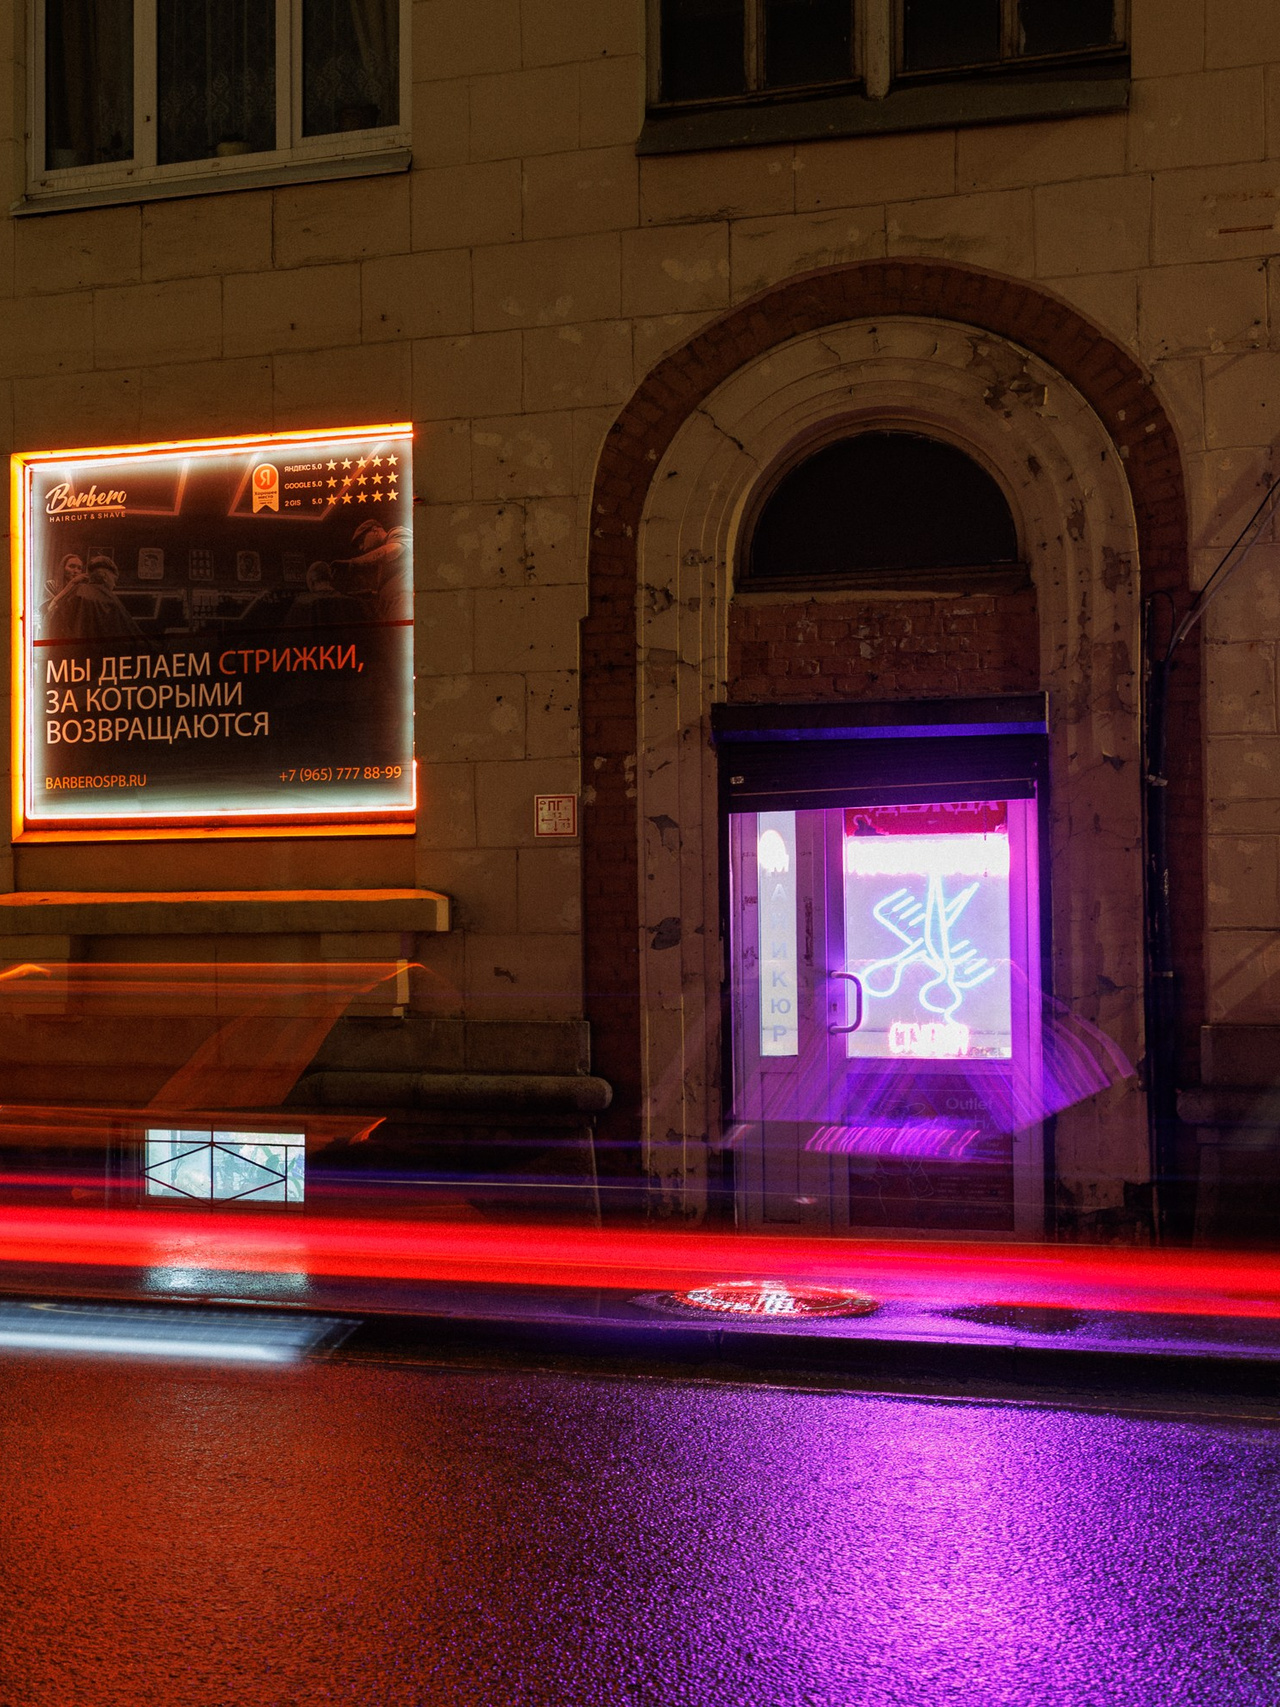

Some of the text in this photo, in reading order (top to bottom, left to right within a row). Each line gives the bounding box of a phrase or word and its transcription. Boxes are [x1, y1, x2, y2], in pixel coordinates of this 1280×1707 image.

[260, 469, 270, 486] Я
[45, 483, 127, 514] Barbero
[49, 514, 87, 522] HAIRCUT
[97, 511, 126, 519] SHAVE
[46, 644, 364, 686] МЫ ДЕЛАЕМ СТРИЖКИ,
[45, 682, 243, 714] ЗА КОТОРЫМИ
[46, 711, 270, 745] ВОЗВРАЩАЮТСЯ
[45, 774, 147, 790] BARBEROSPB.RU
[279, 766, 401, 782] +7 (965) 777 88-99
[548, 801, 562, 811] ПГ
[889, 1022, 969, 1055] СТУДЯ
